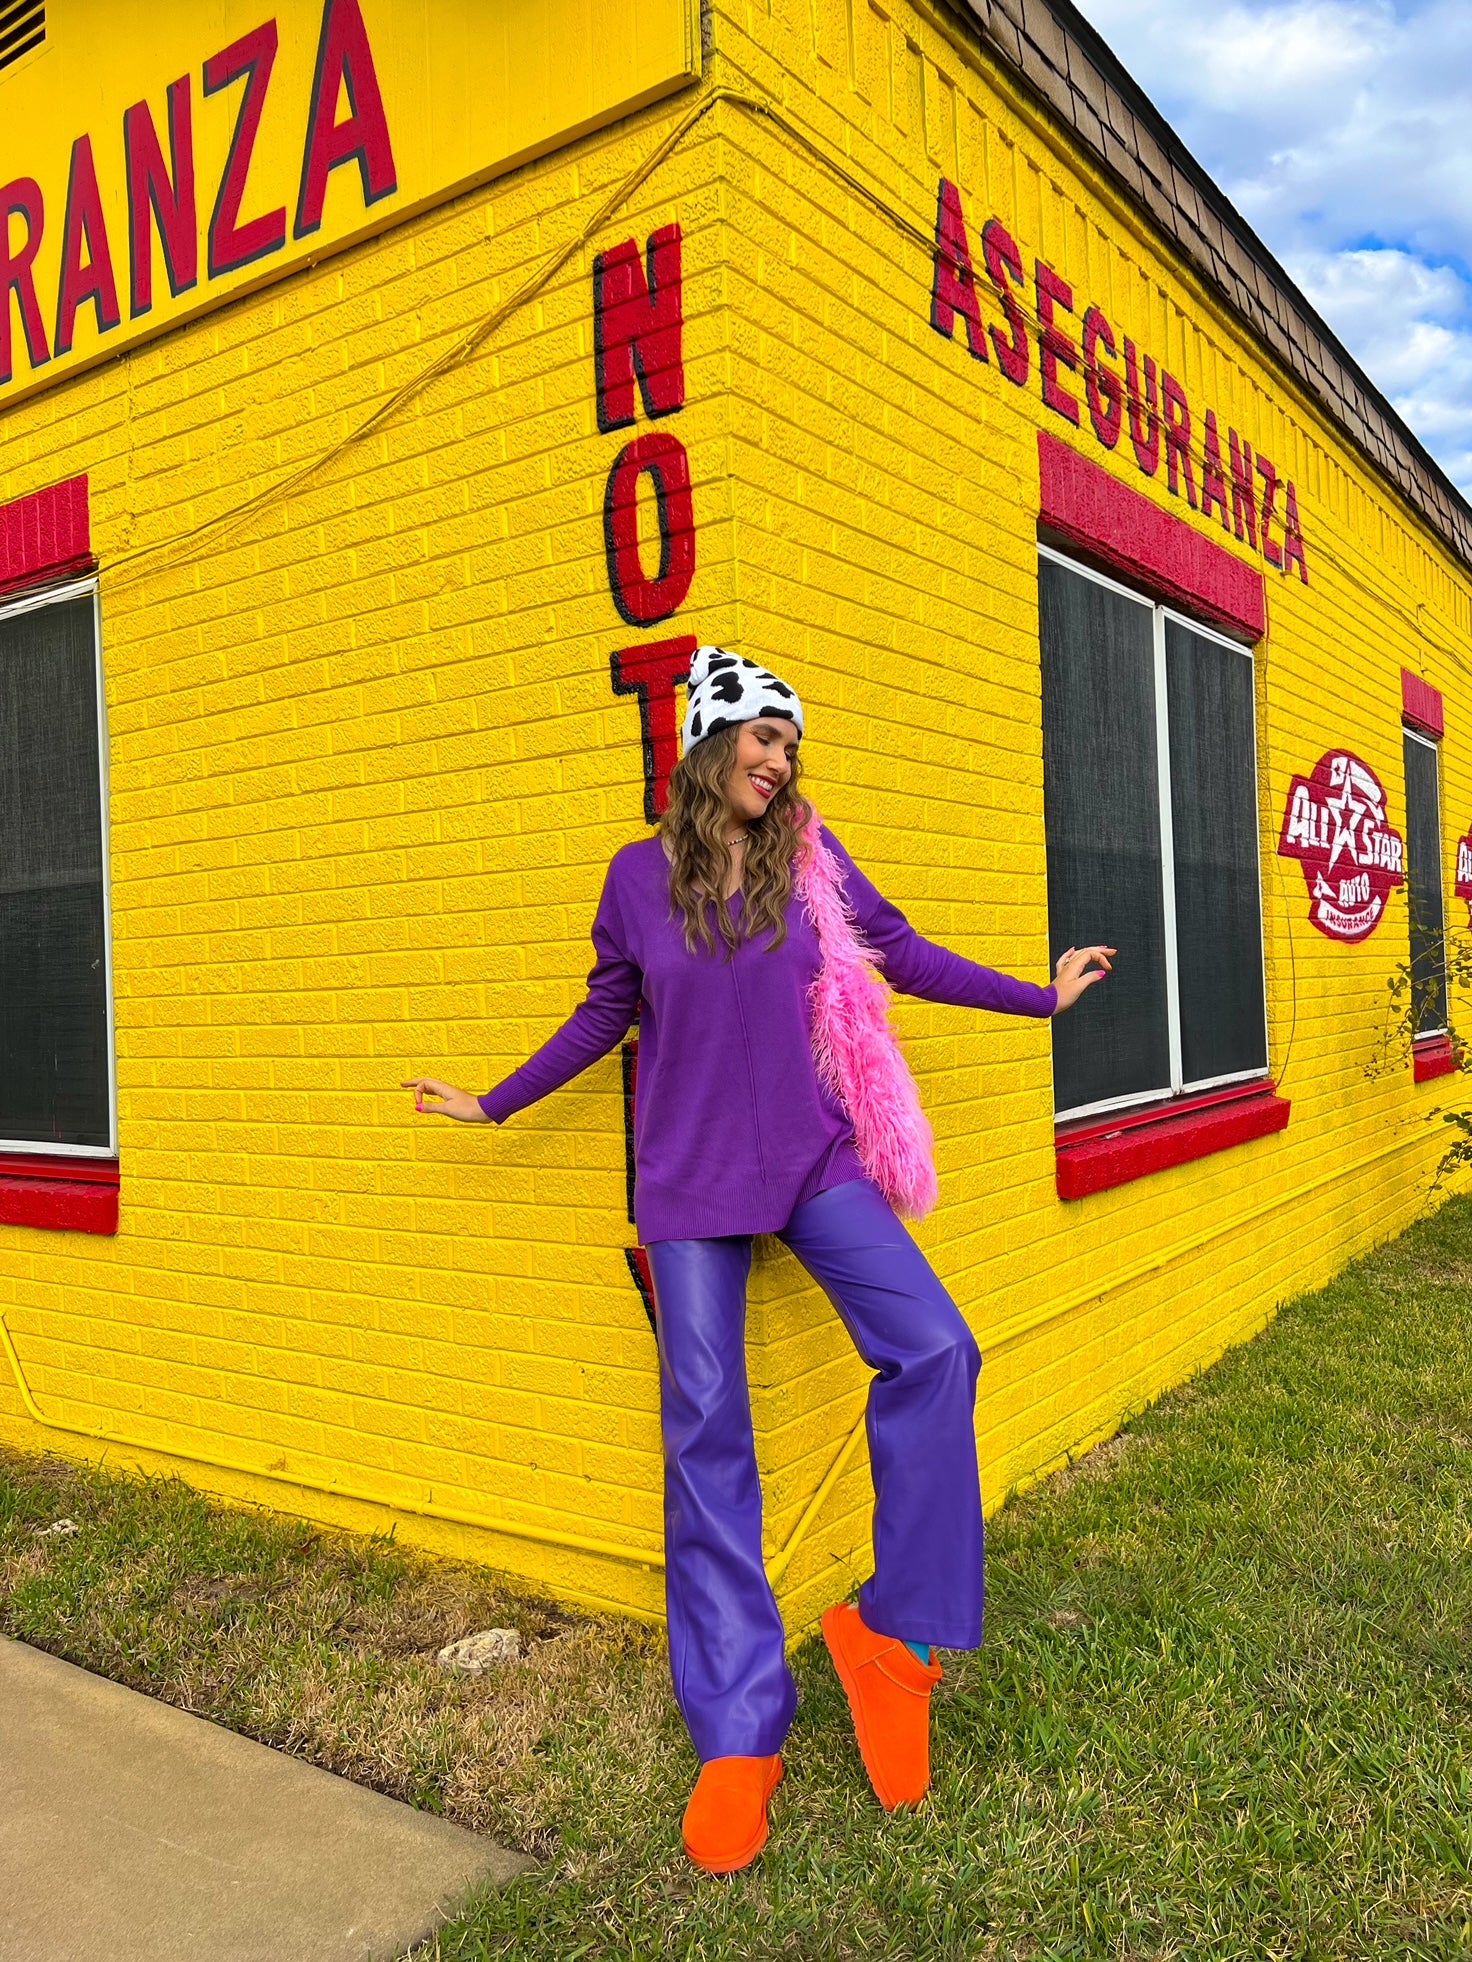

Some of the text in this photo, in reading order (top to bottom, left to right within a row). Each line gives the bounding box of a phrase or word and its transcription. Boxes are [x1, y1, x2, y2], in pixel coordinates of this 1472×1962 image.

[930, 178, 1309, 584] ASEGURANZA
[1286, 785, 1403, 873] ALL STAR
[1326, 906, 1374, 930] INSURANCE
[1338, 872, 1370, 908] AUTO
